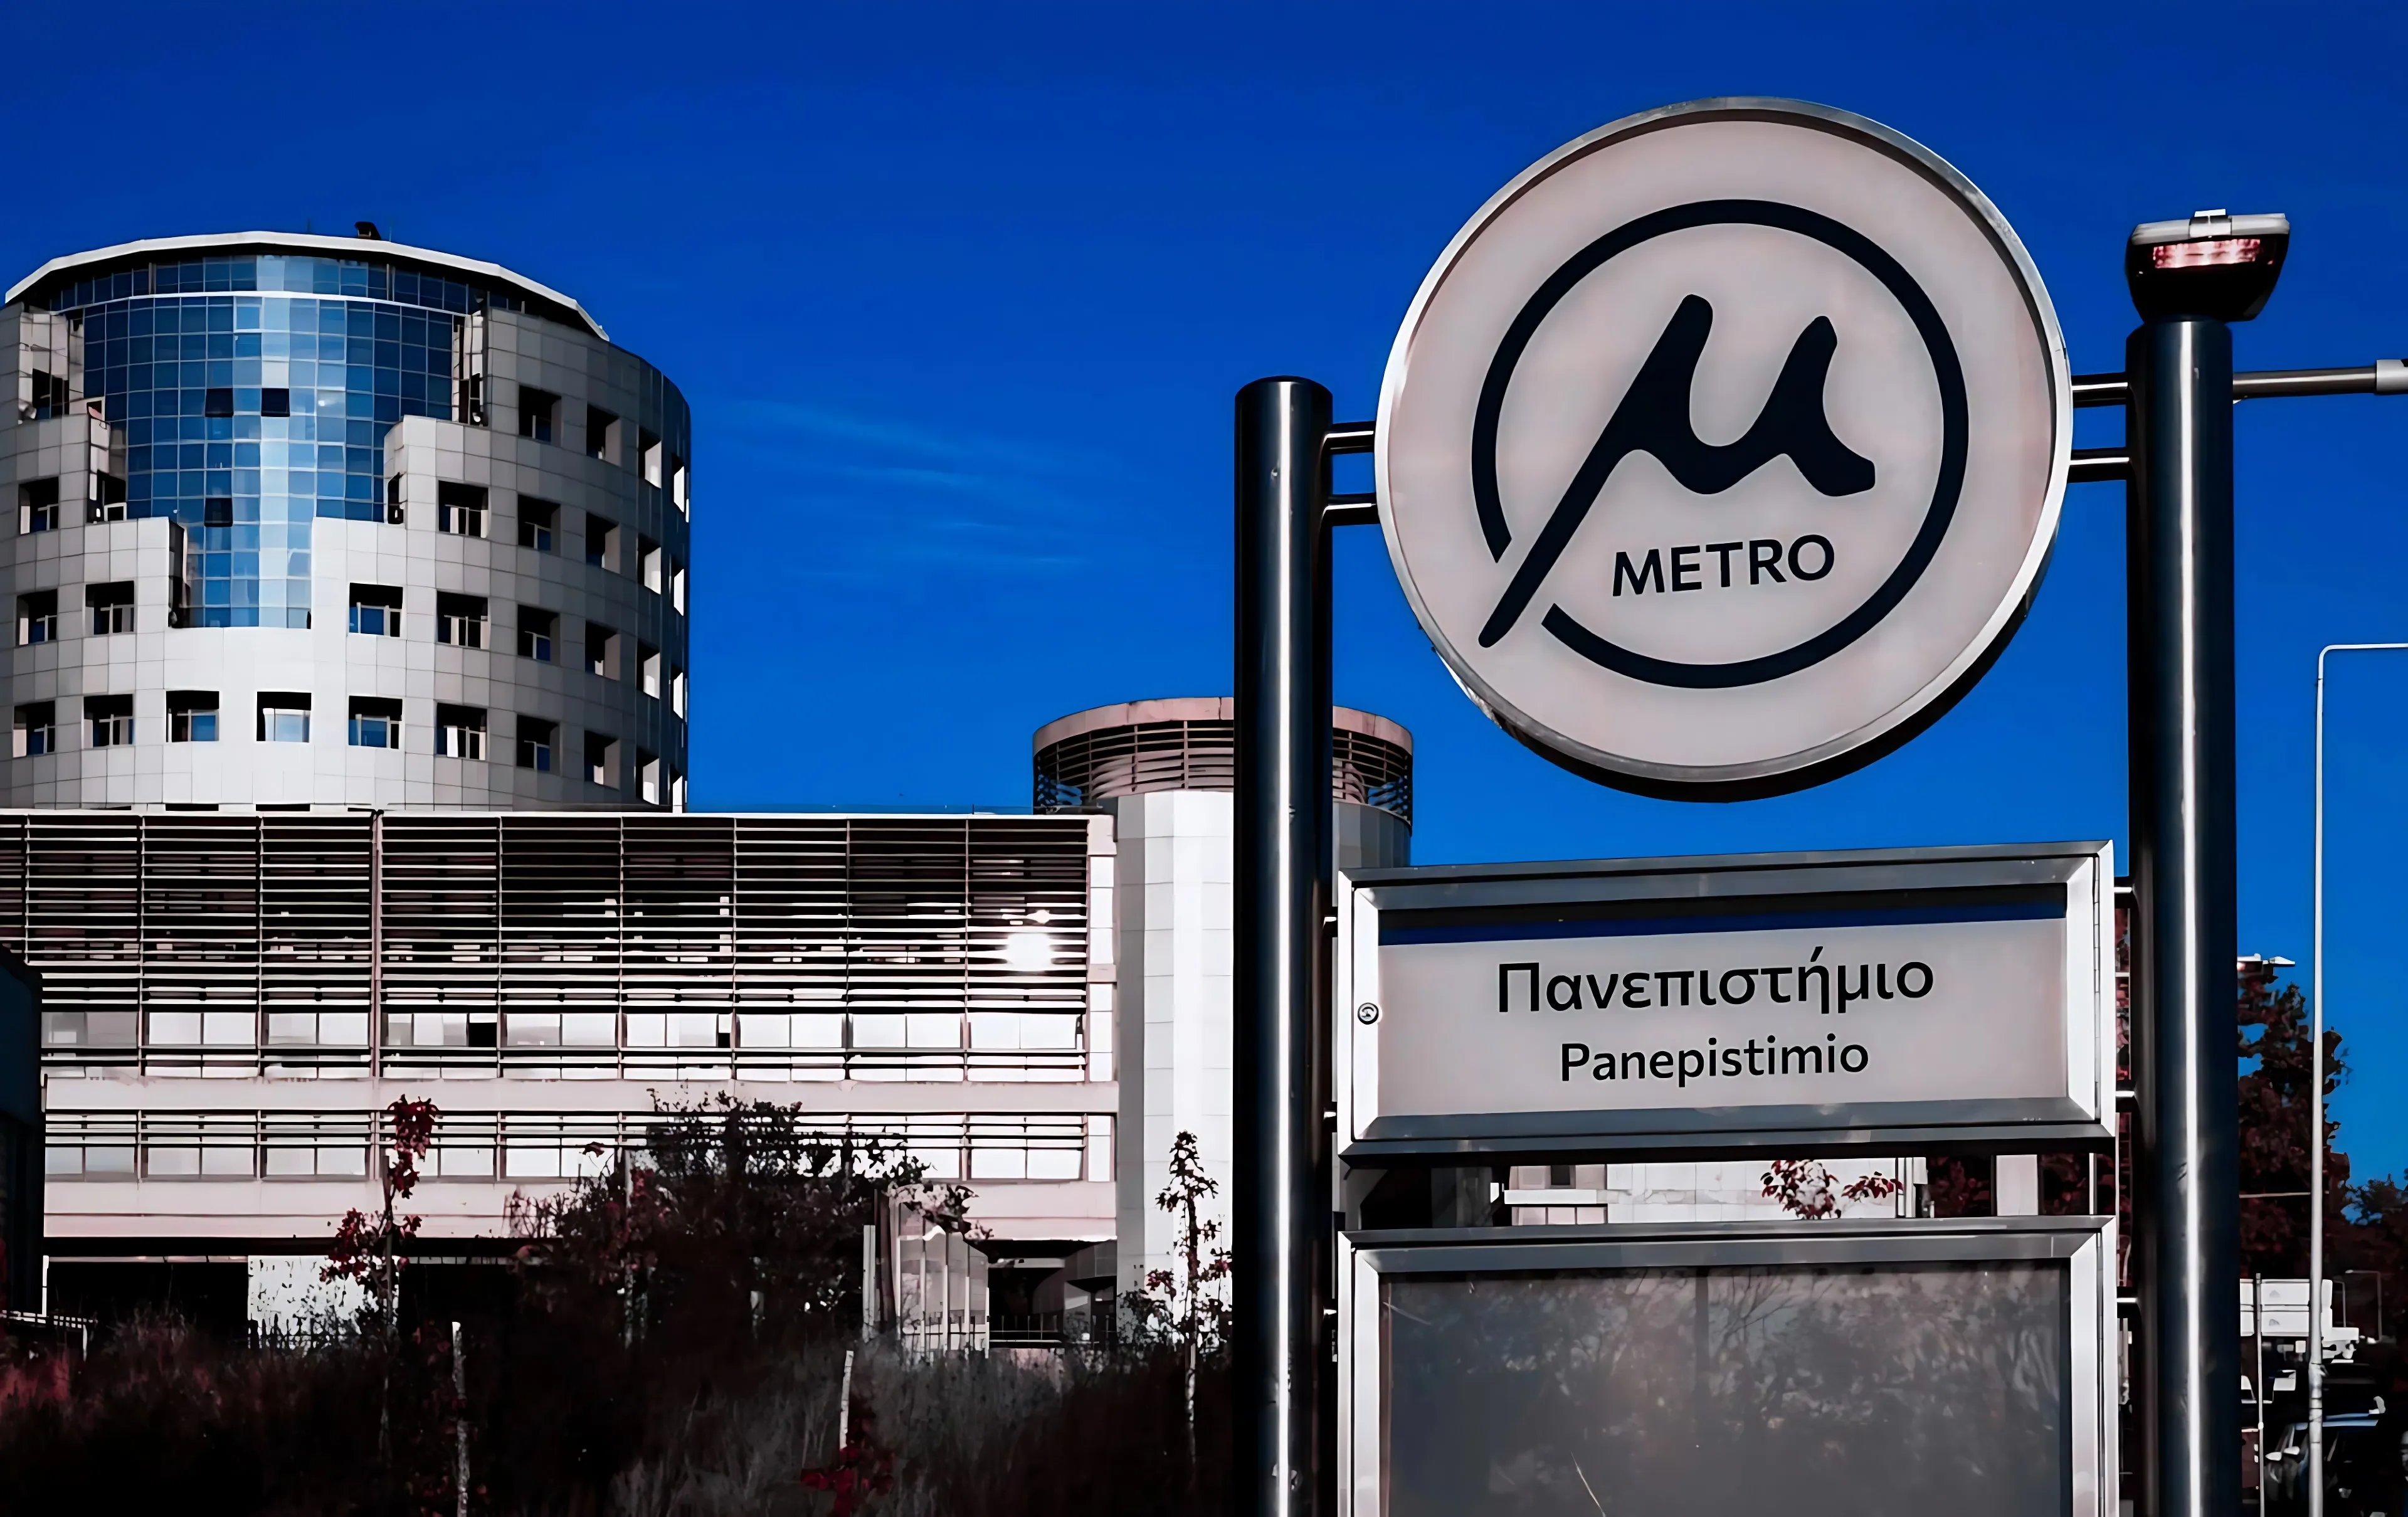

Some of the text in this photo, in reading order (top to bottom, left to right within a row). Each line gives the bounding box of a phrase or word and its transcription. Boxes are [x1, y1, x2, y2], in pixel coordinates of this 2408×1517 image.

[1612, 534, 1835, 597] METRO
[1499, 946, 1934, 1015] Πανεπιστήμιο
[1561, 1033, 1869, 1088] Panepistimio
